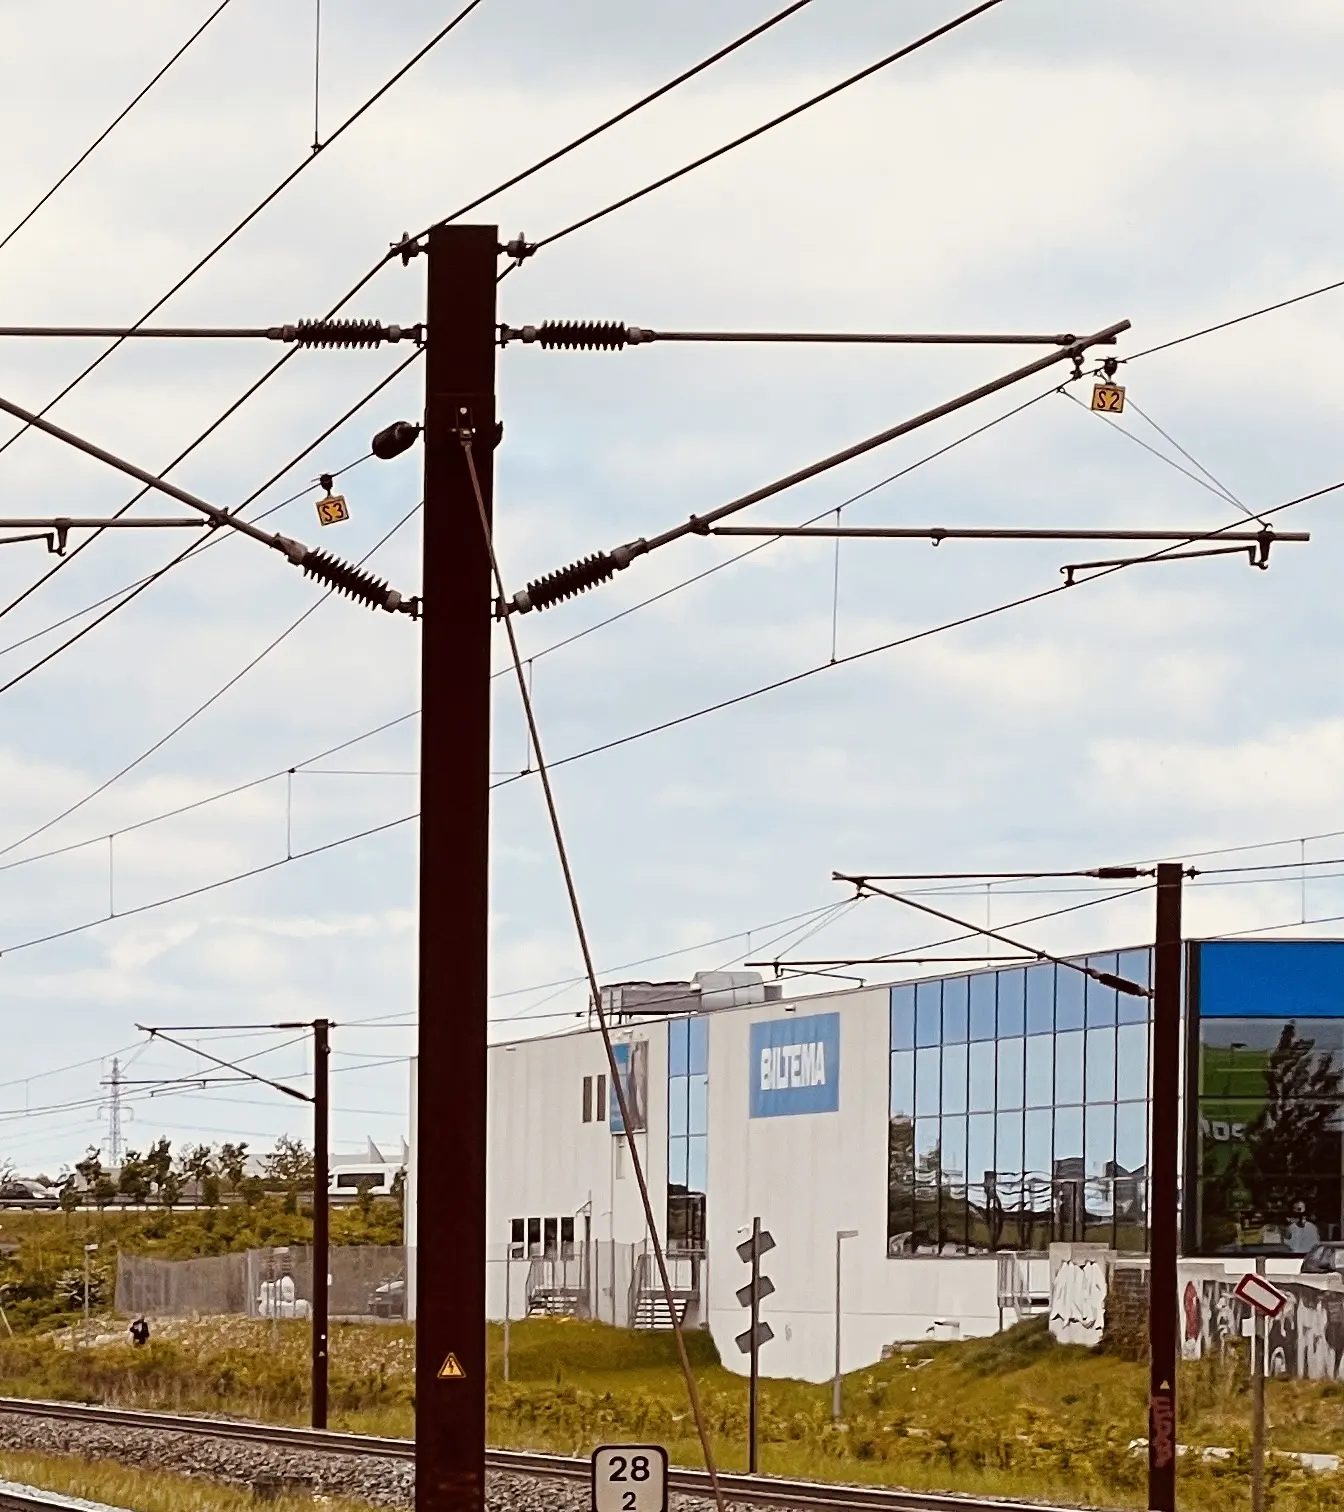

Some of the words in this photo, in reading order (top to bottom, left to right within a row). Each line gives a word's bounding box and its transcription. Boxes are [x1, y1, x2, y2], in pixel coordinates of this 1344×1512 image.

[760, 1041, 826, 1091] BILTEMA
[608, 1455, 650, 1482] 28
[621, 1491, 637, 1511] 2
